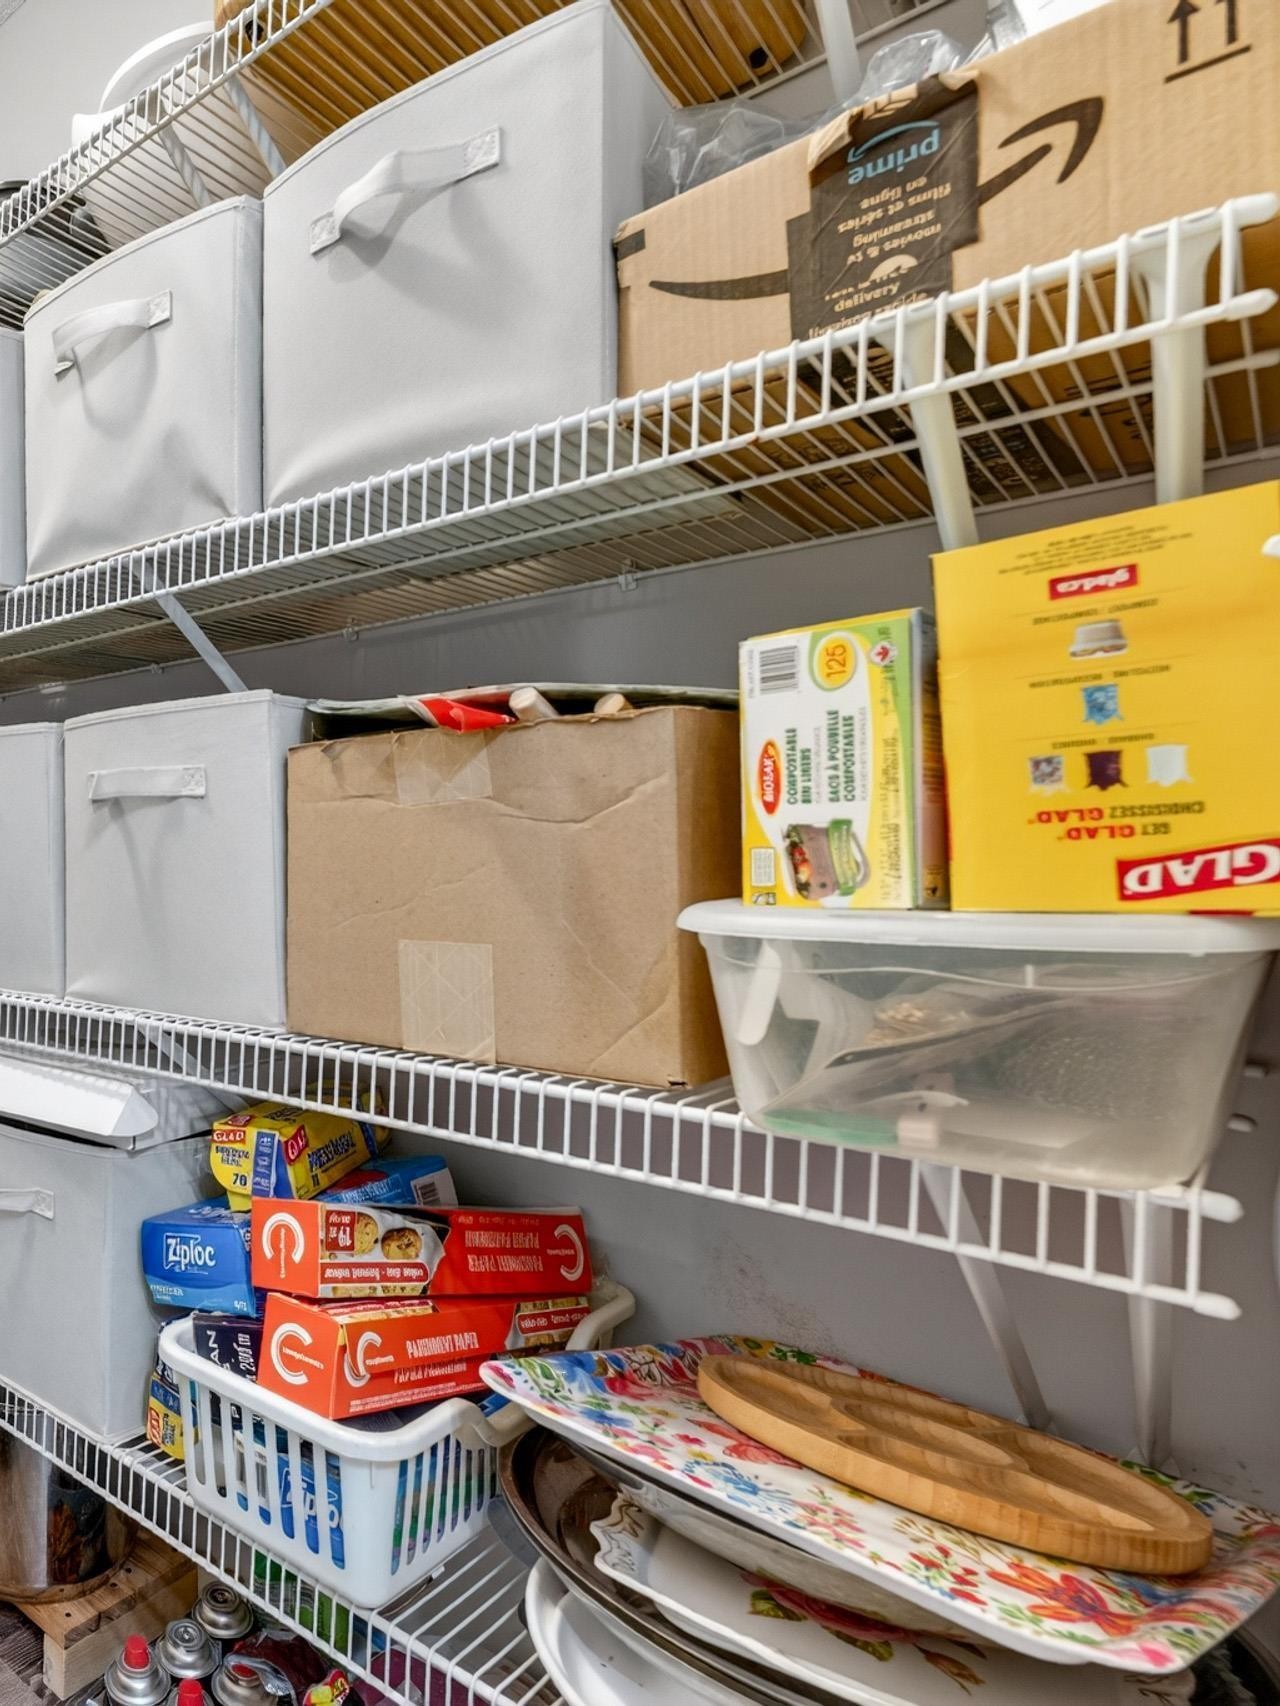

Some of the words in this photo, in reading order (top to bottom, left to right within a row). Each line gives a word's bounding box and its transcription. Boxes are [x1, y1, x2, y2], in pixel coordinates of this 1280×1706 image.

[848, 128, 940, 185] prime
[859, 186, 902, 210] ligne
[906, 176, 928, 193] en
[907, 182, 952, 208] films
[837, 207, 884, 234] séries
[887, 200, 905, 216] et
[852, 208, 936, 248] streaming
[883, 223, 942, 252] movies
[833, 280, 901, 313] delivery
[825, 643, 848, 680] 125
[826, 710, 840, 762] POUBELLE
[785, 728, 798, 806] COMPOSTABLE
[842, 715, 855, 802] COMPOSTABLES
[1035, 806, 1104, 824] GLAD
[1065, 823, 1136, 841] GLAD
[1123, 843, 1280, 894] GLAD
[213, 1130, 244, 1142] GLAD
[232, 1172, 247, 1186] 70
[165, 1237, 217, 1271] Ziploc
